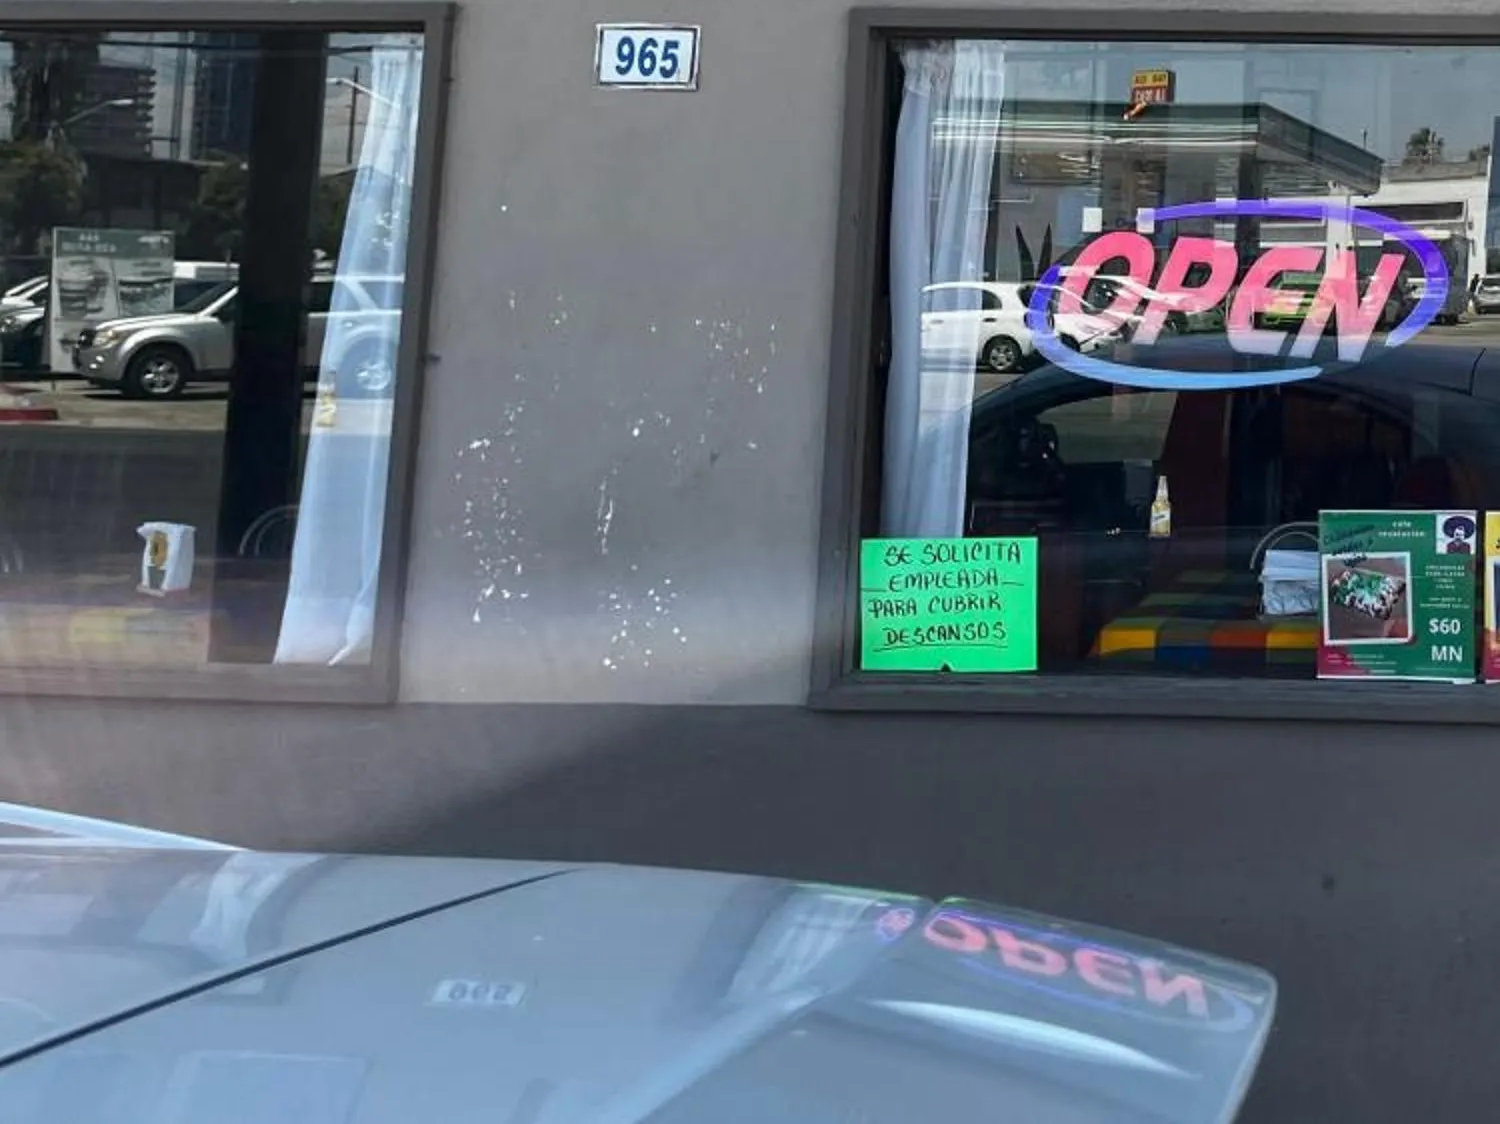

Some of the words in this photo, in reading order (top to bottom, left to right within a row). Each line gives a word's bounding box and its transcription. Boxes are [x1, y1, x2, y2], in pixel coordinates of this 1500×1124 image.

[616, 36, 679, 78] 965
[1058, 231, 1405, 363] OPEN
[884, 545, 912, 566] SE
[920, 541, 1021, 565] SOLICITA
[889, 567, 999, 592] EMPLEADA
[868, 598, 917, 619] PARA
[928, 591, 1002, 614] CUBRIR
[883, 621, 1006, 645] DESCANSOS
[1429, 618, 1461, 635] $60
[1431, 645, 1463, 662] MN
